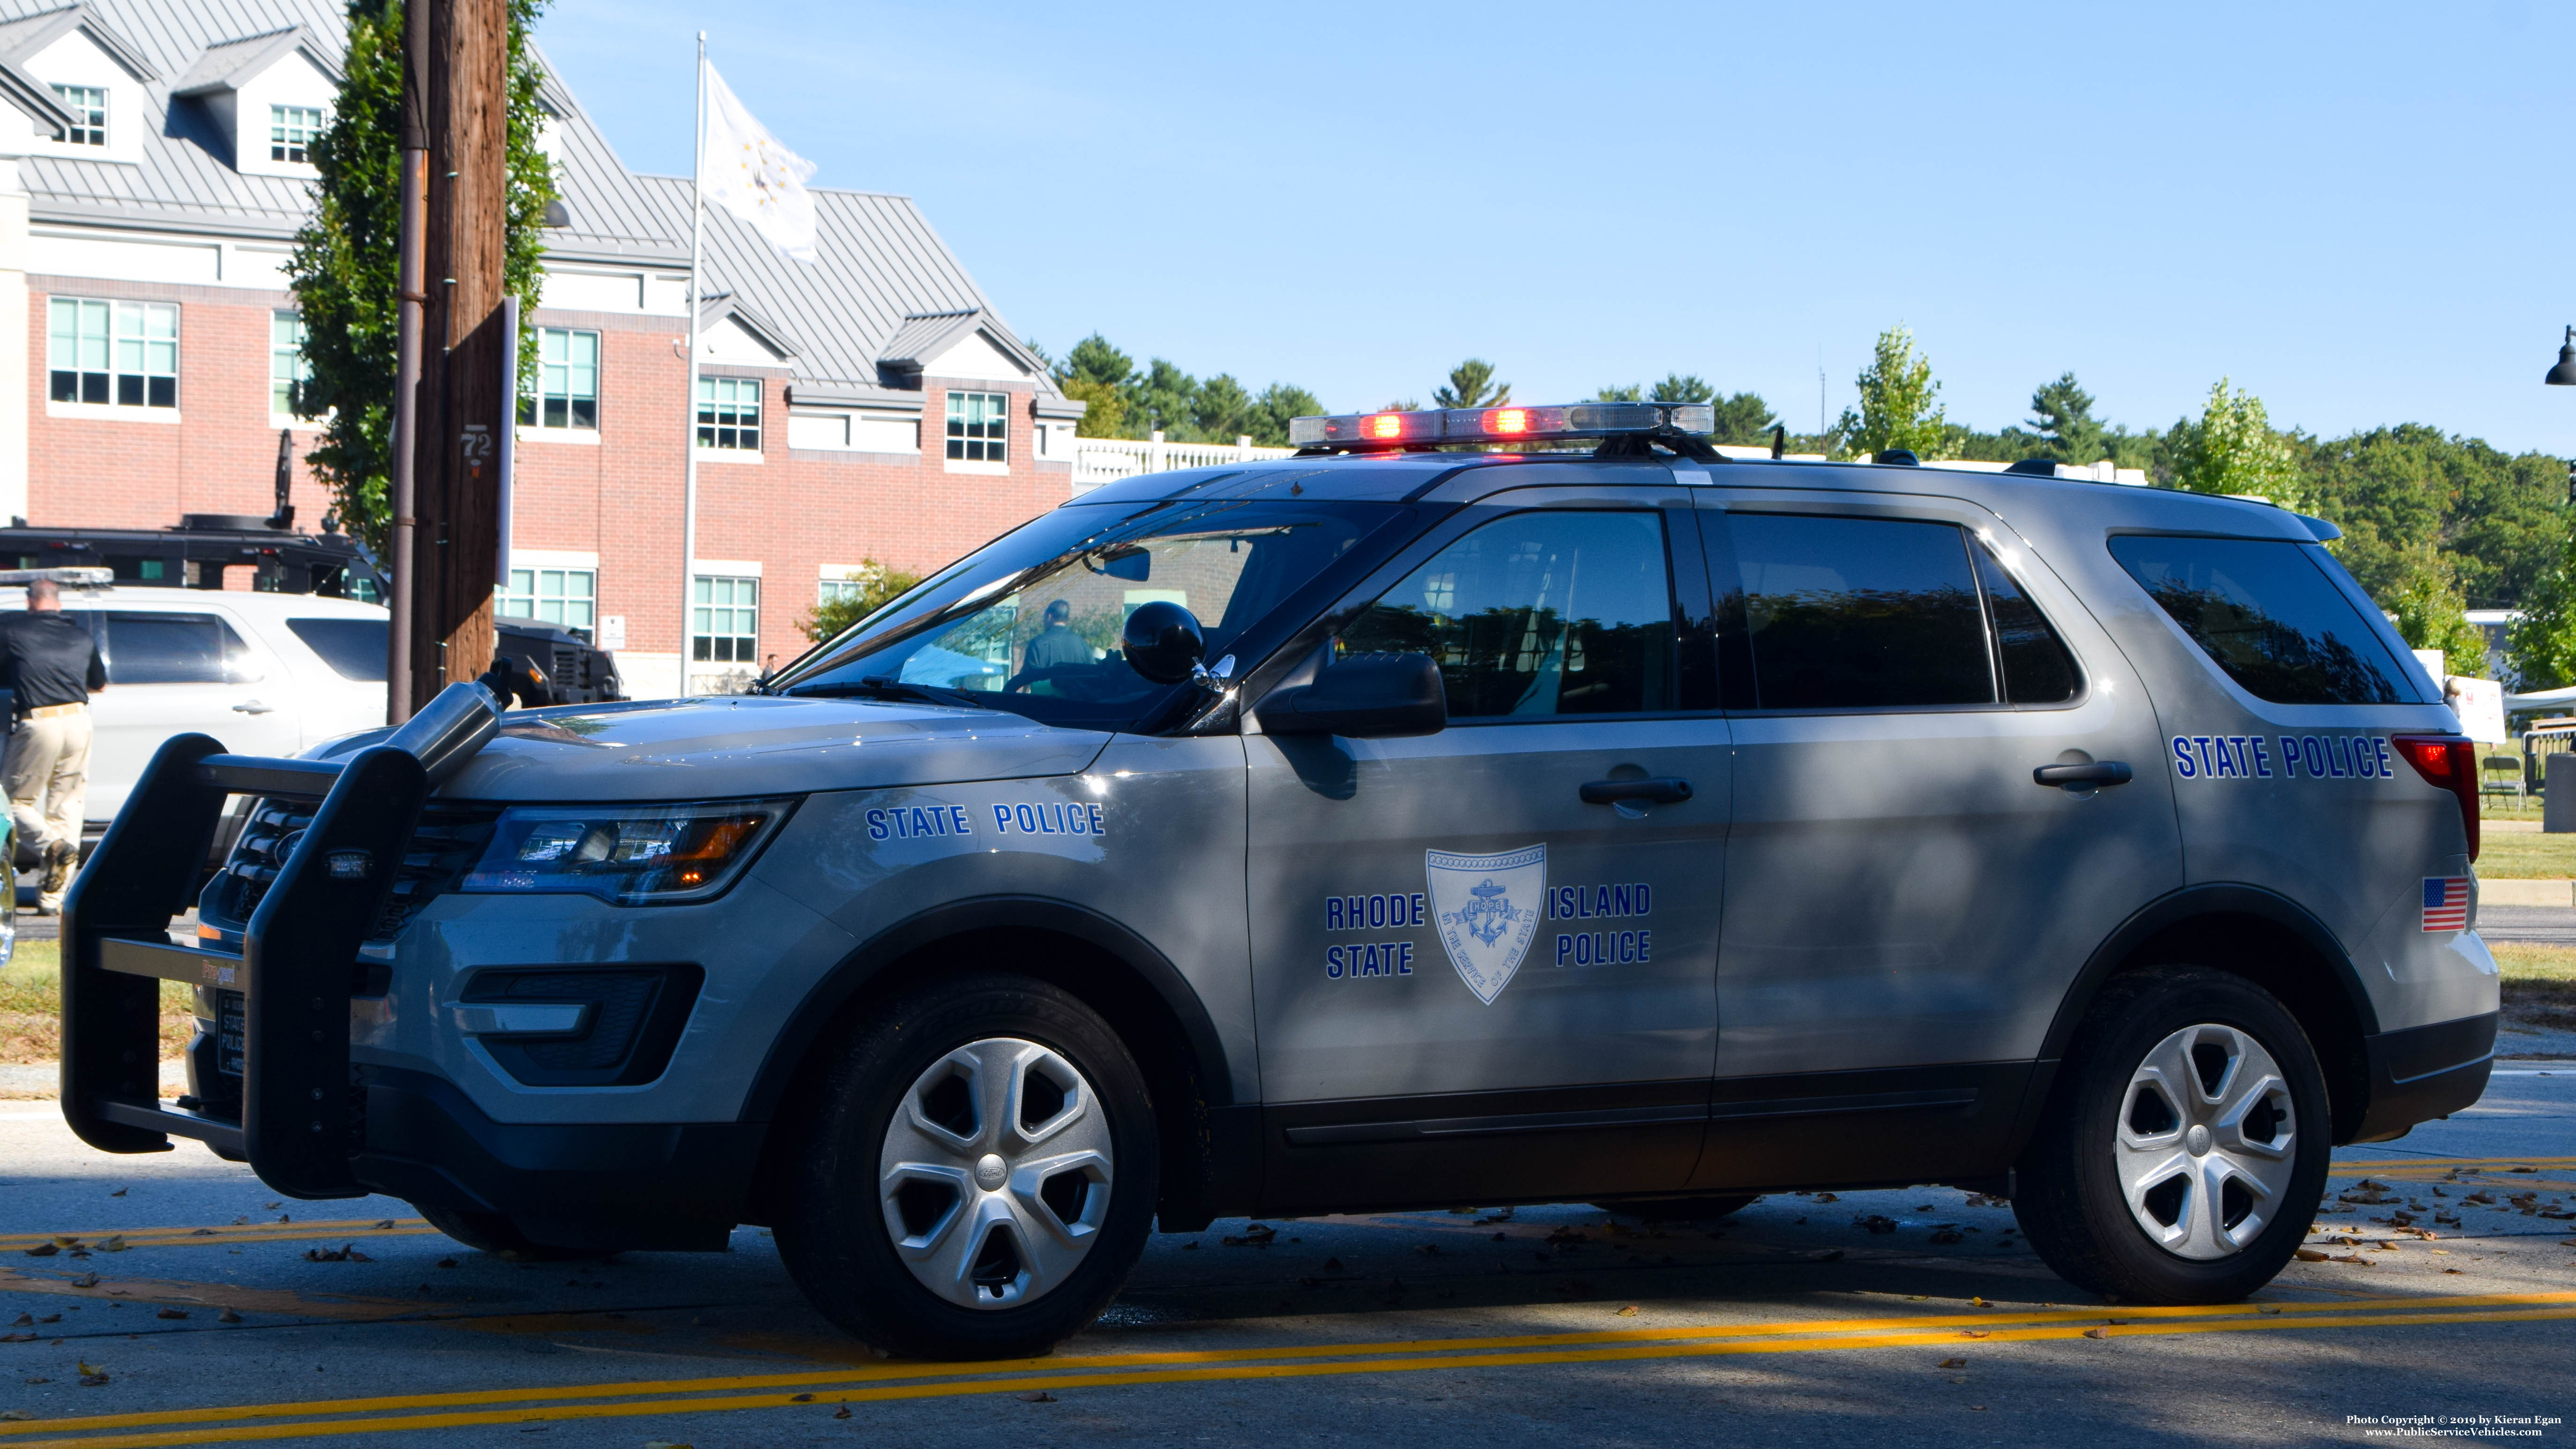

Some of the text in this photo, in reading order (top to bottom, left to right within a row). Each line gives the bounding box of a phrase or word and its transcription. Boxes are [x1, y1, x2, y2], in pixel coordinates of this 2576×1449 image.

[460, 433, 492, 456] 72
[2172, 735, 2394, 779] STATE POLICE
[865, 802, 1105, 841] STATE POLICE
[1326, 883, 1651, 931] RHODE ISLAND
[1474, 901, 1501, 910] HOPE
[1327, 930, 1650, 979] STATE POLICE
[1441, 909, 1534, 988] IN THE SERVICE OF THE STATE
